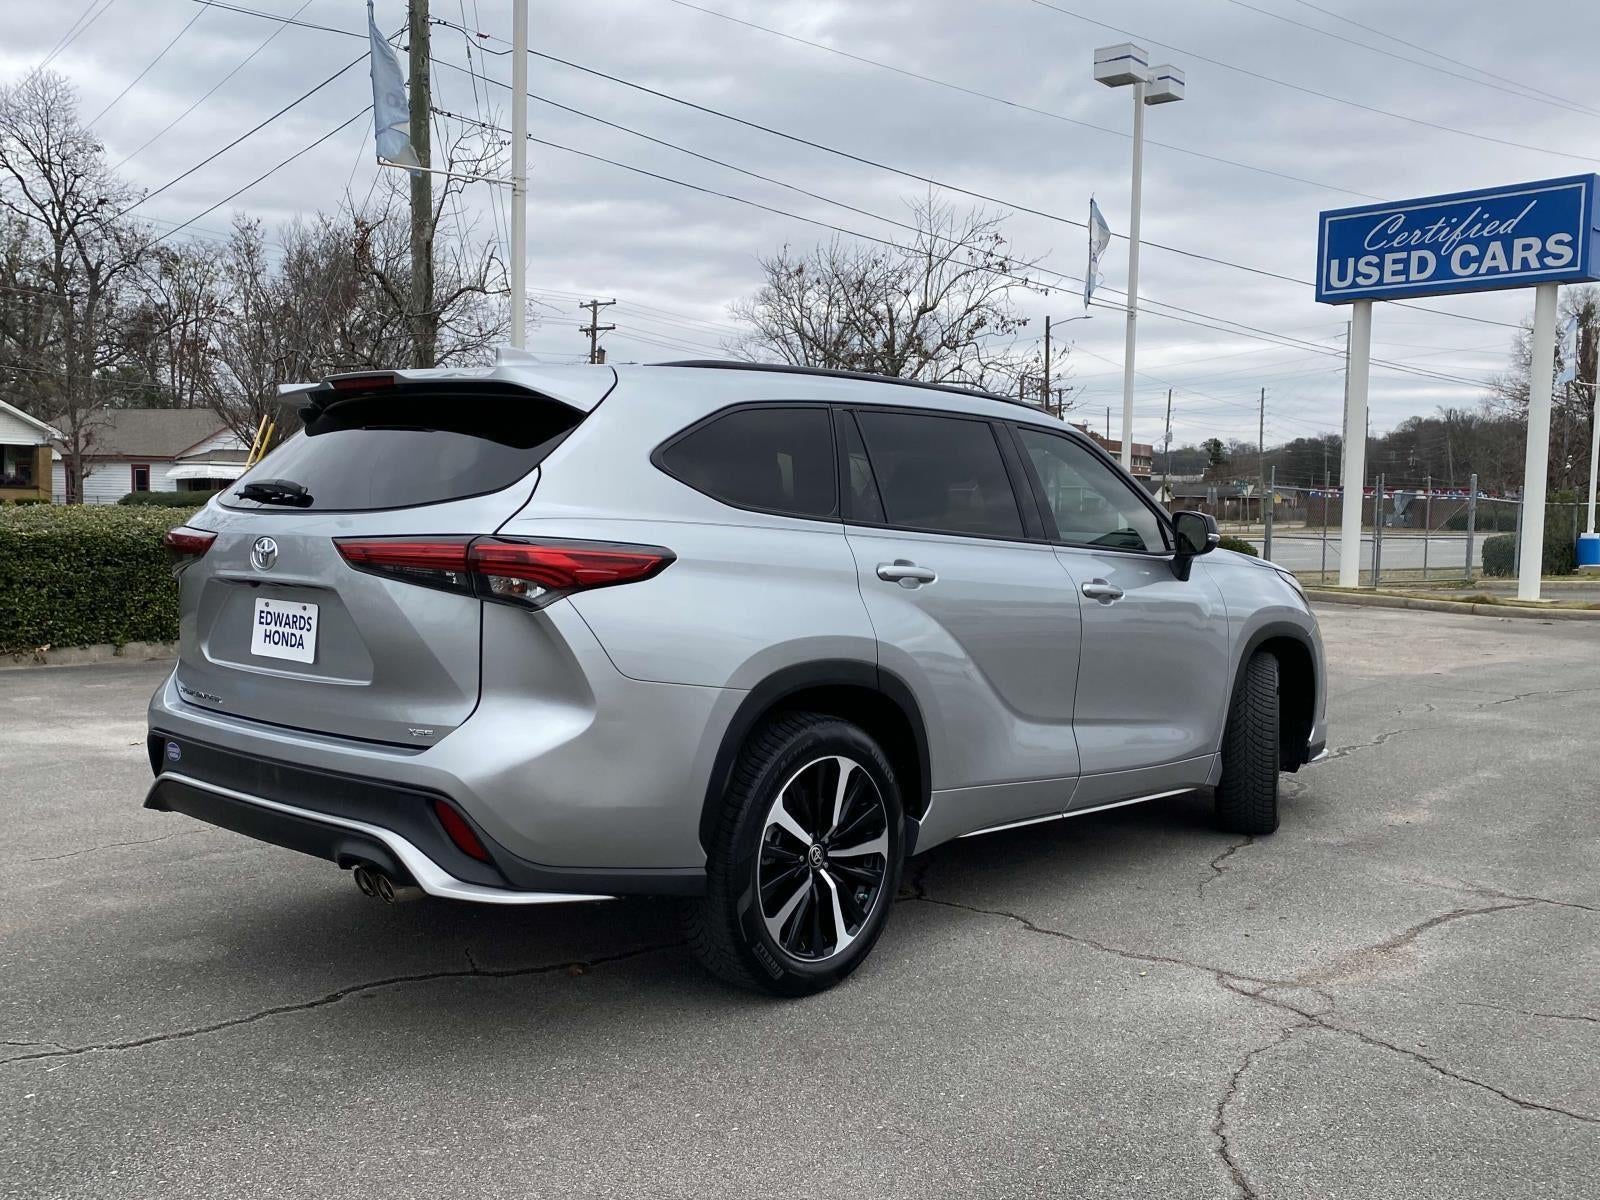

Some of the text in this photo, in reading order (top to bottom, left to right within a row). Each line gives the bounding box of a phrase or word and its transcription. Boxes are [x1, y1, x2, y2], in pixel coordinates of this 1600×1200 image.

[1363, 199, 1538, 256] Certified
[1329, 232, 1574, 289] USED CARS
[258, 609, 313, 632] EDWARDS
[263, 629, 305, 650] HONDA
